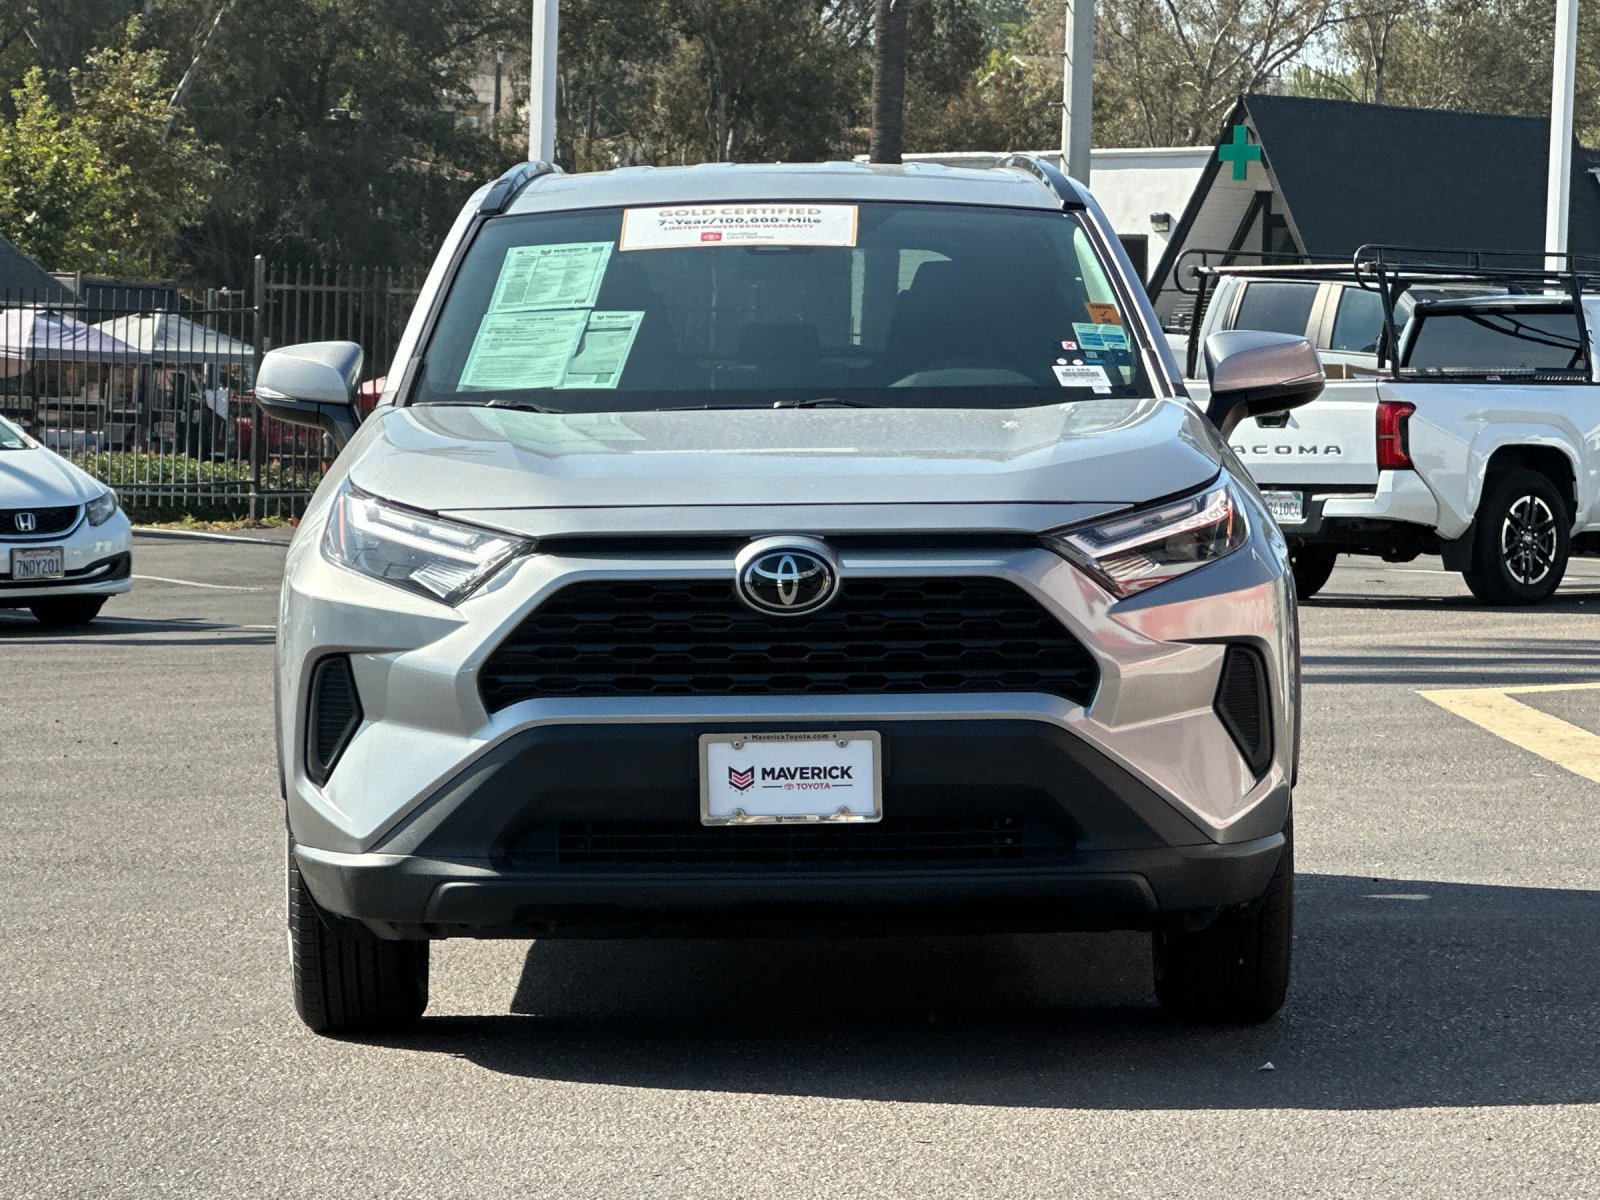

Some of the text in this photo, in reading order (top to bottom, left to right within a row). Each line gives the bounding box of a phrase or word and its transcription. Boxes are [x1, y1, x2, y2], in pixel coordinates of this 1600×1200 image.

[658, 207, 822, 217] GOLD CERTIFIED
[658, 217, 822, 226] 7-Year/100,000-Mile
[1232, 444, 1343, 455] ACOMA
[751, 733, 829, 741] MaverickToyota.com
[761, 765, 853, 781] MAVERICK
[795, 782, 831, 790] TOYOTA
